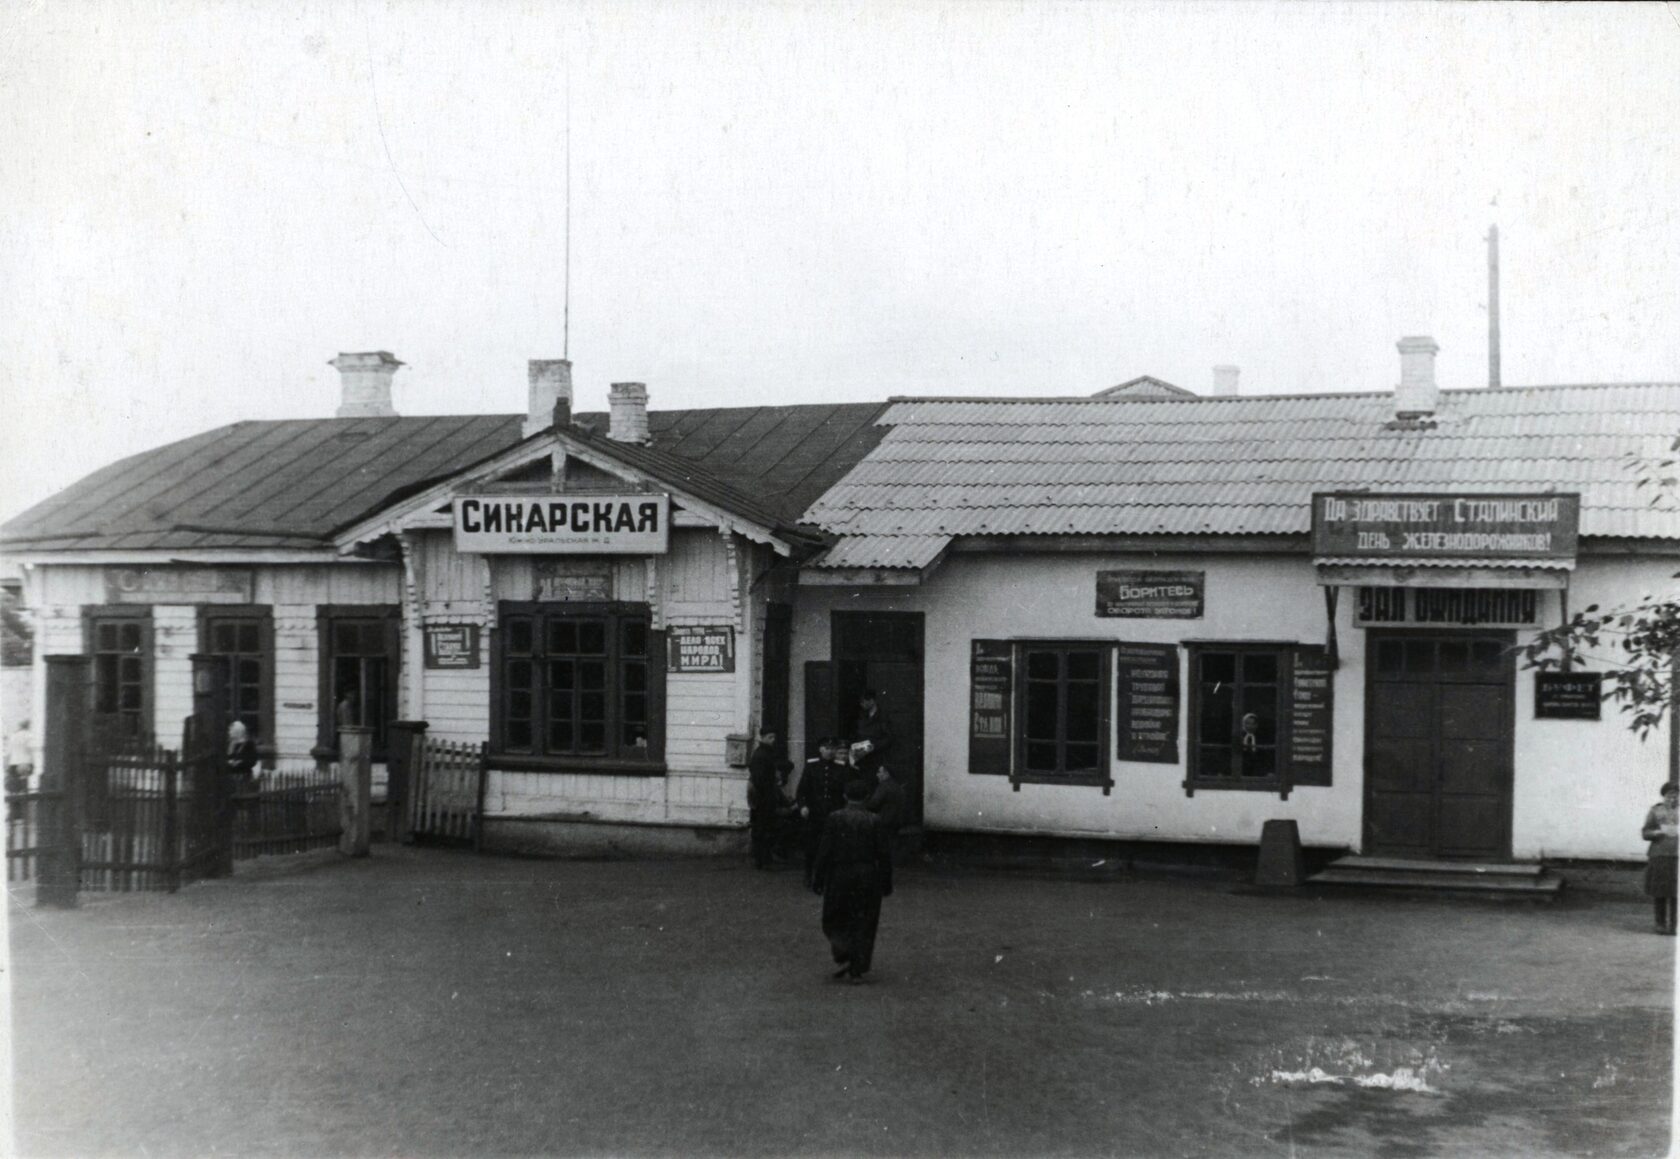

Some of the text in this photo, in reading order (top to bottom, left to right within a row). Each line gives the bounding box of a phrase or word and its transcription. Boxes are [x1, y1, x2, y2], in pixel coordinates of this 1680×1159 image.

[462, 499, 658, 533] СИНАРСКАЯ
[1324, 496, 1561, 522] ДА ЗДРАВСТВУЕТ СТАЛИНСКИЙ
[1357, 531, 1552, 551] ДЕНЬ ЖЕЛЕЗНОДОРОЖНИКОВ!
[1120, 585, 1194, 600] БОРИТЕСЬ
[680, 645, 720, 655] НАРОДОВ
[680, 654, 724, 667] МИРА!
